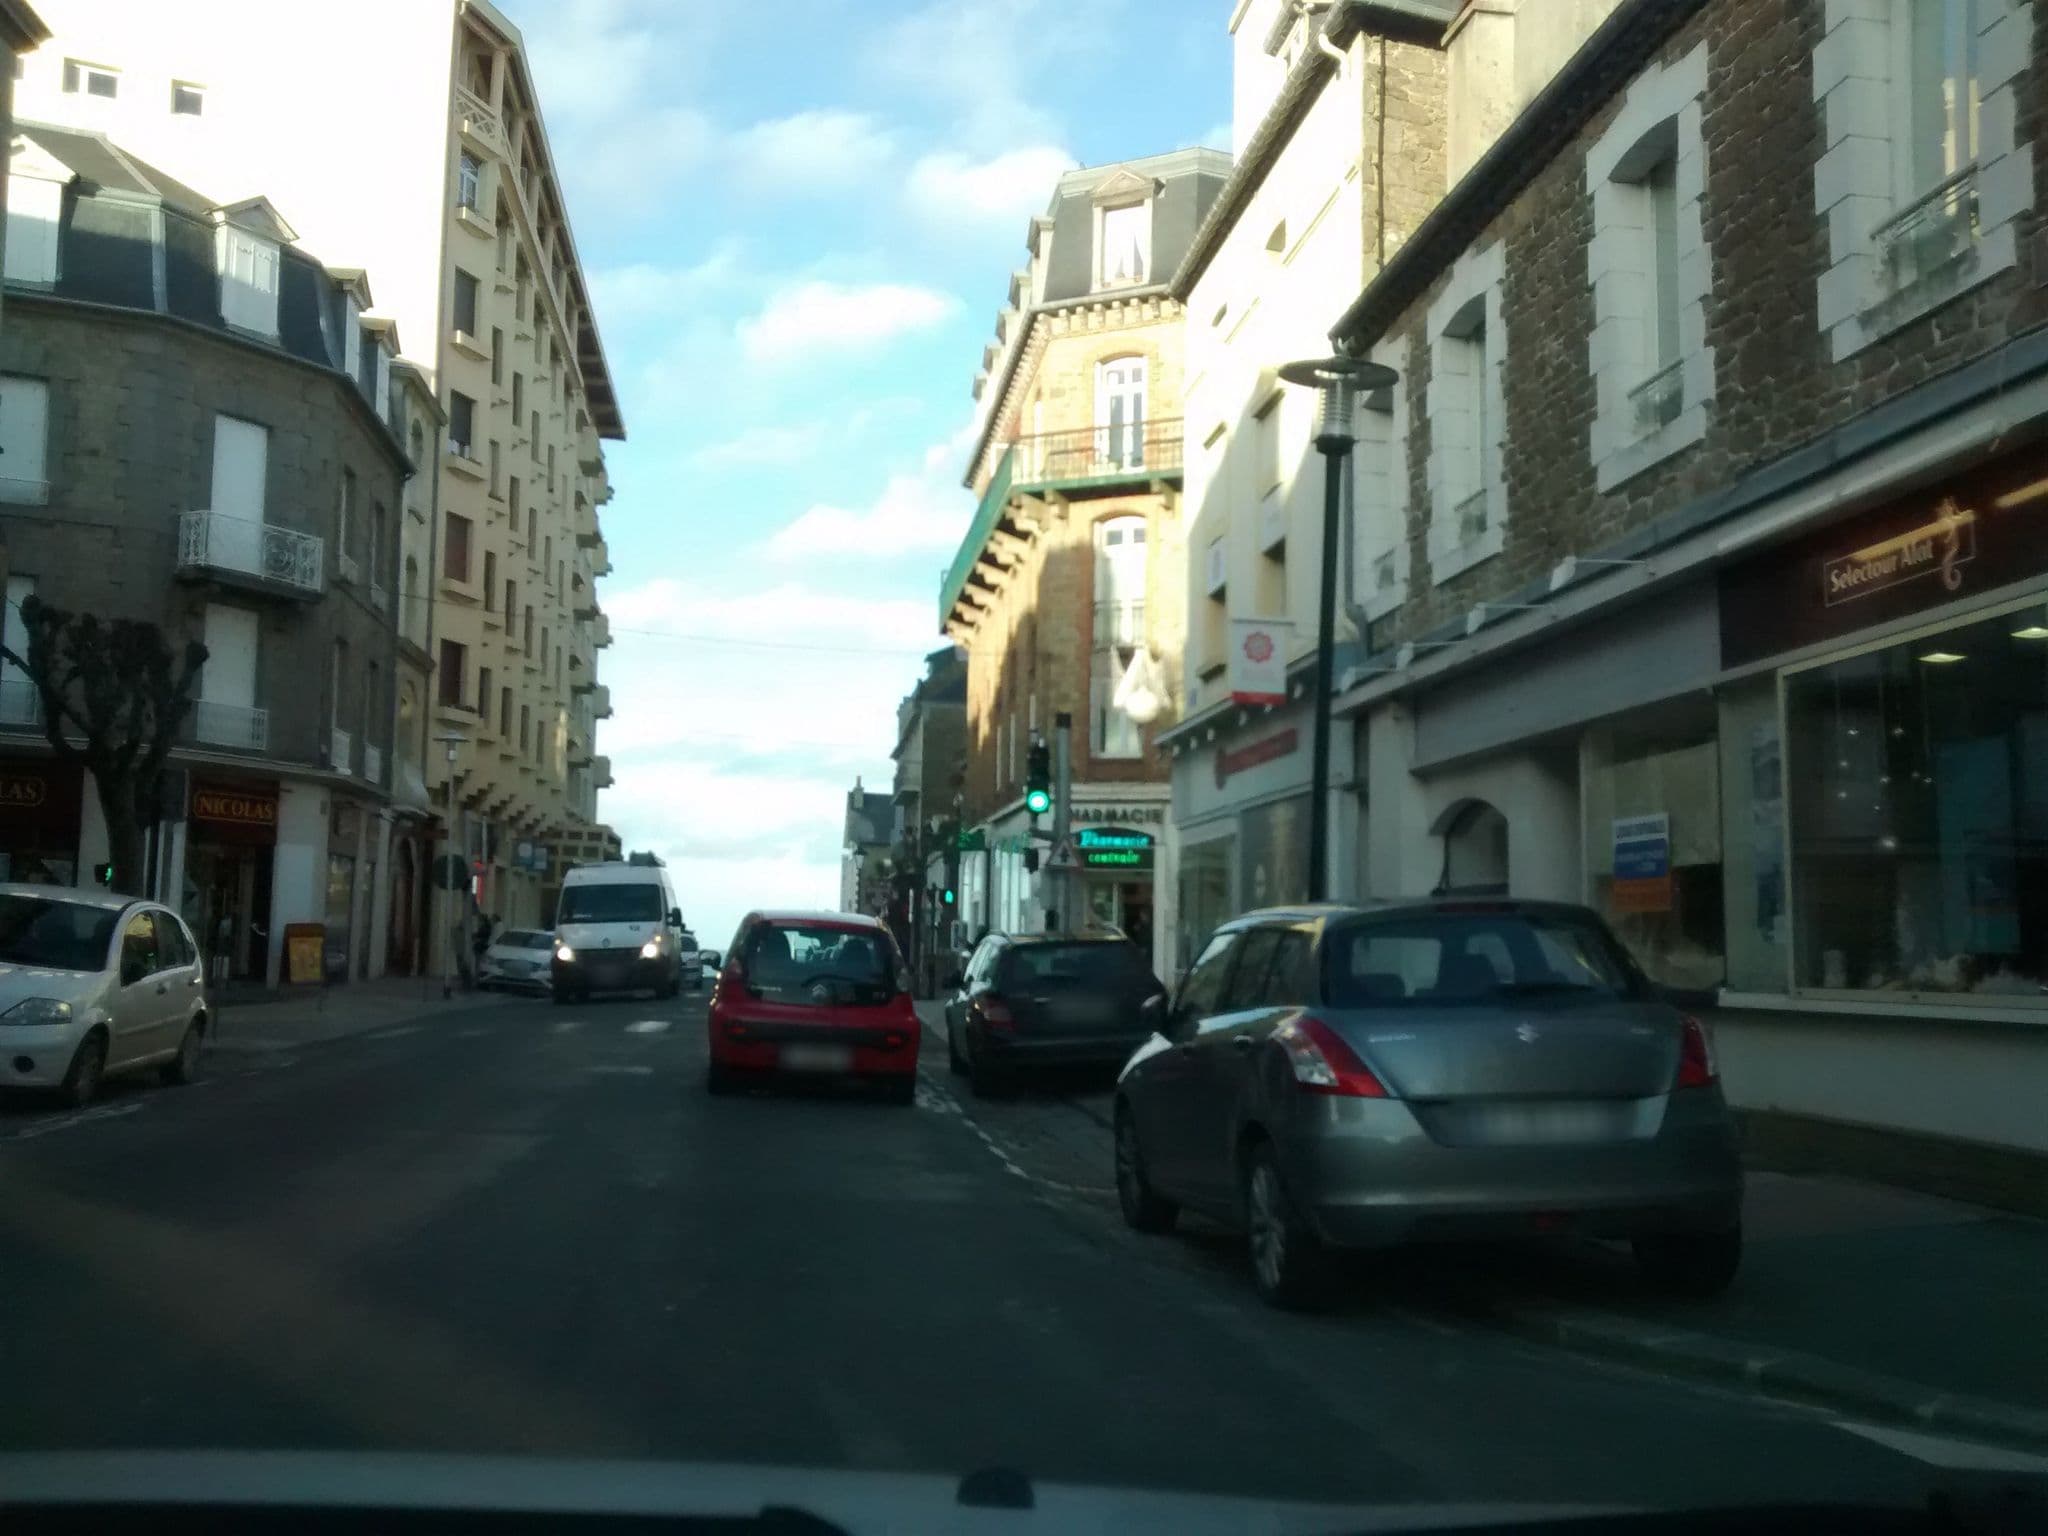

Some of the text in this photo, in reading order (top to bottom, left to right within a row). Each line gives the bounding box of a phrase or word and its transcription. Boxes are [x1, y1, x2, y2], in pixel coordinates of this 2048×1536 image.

[1830, 556, 1897, 592] Selectour
[199, 796, 274, 818] NICOLAS
[1069, 808, 1163, 824] HARMACIE
